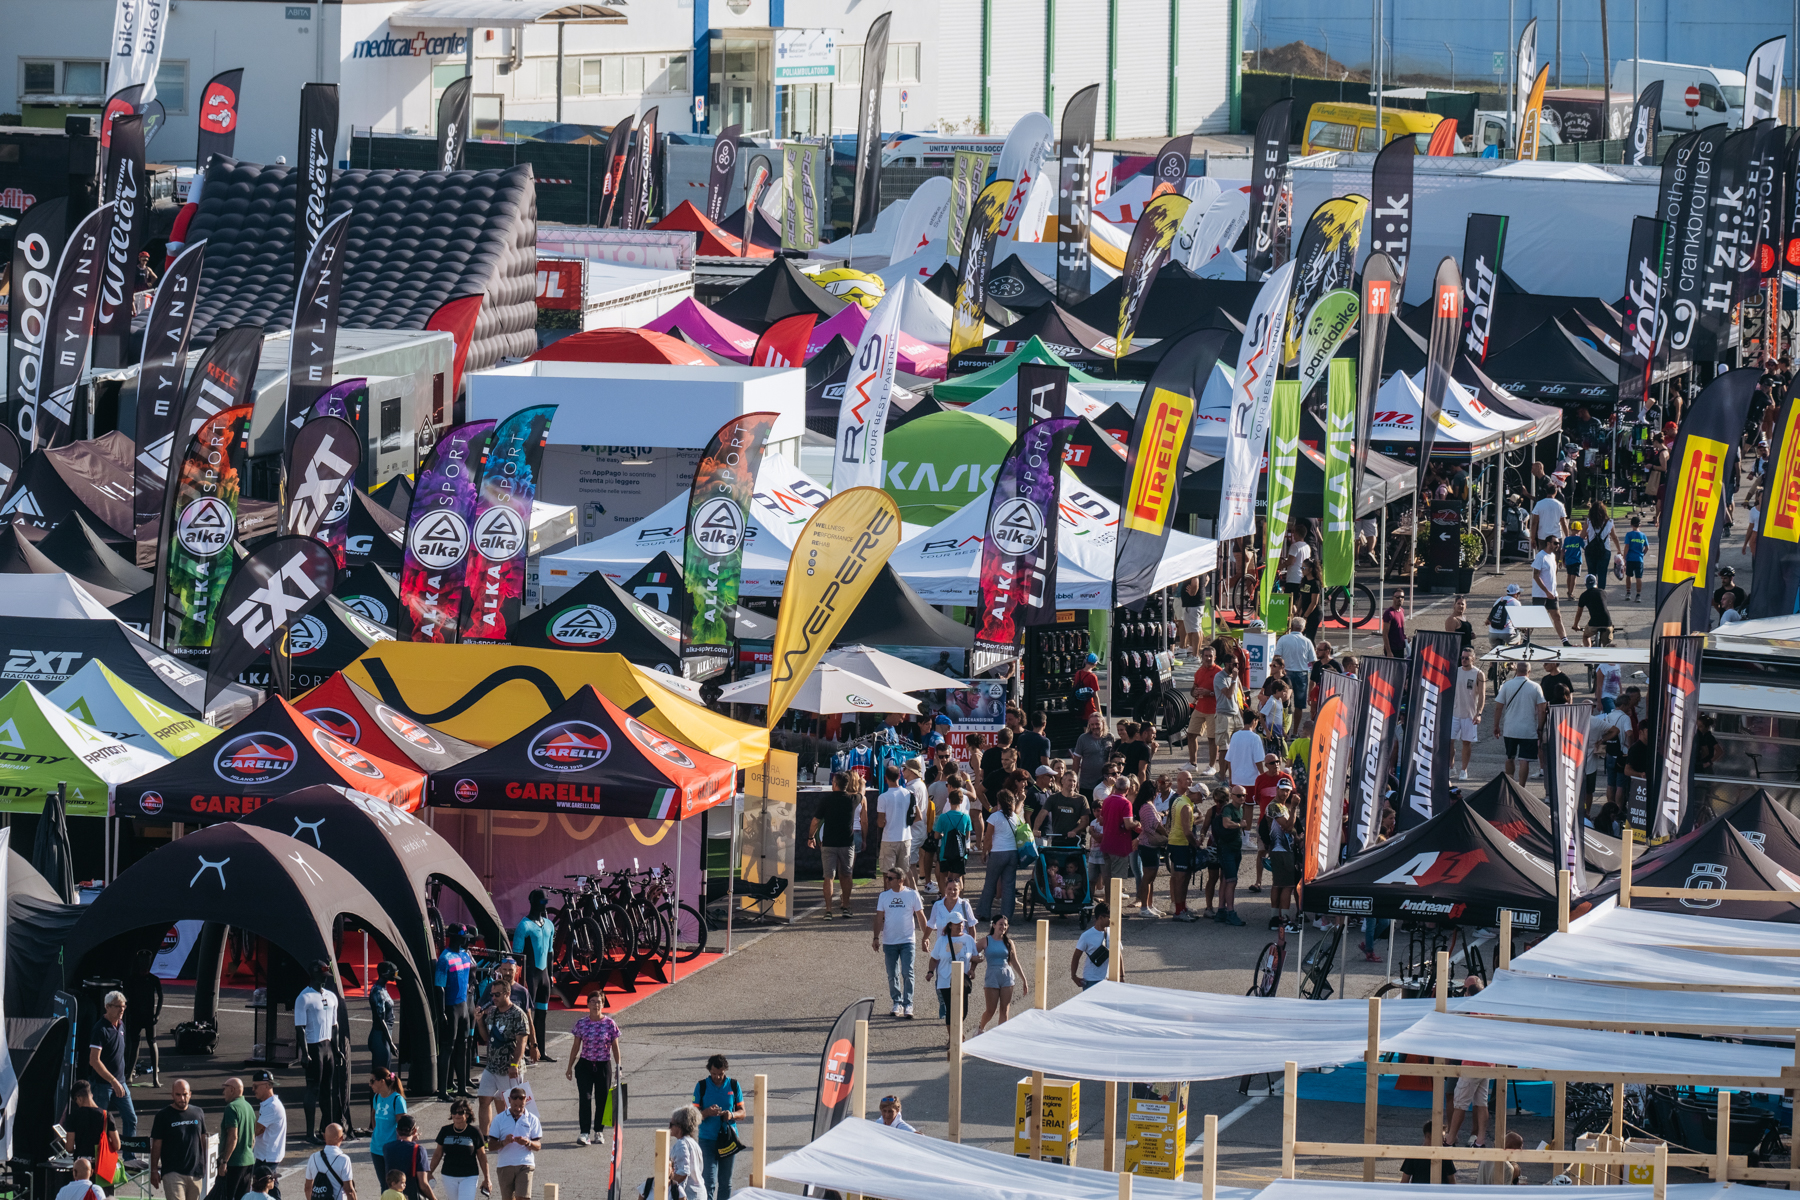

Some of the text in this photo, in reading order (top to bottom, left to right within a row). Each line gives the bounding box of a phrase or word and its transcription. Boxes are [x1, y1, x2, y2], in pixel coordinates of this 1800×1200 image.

[782, 66, 829, 77] POLIAMBULATORIO
[1577, 117, 1592, 128] EAT
[308, 128, 317, 181] TRIESTINA
[640, 123, 651, 217] ANACONDA
[113, 157, 127, 214] TRIESTINA
[802, 149, 814, 246] AGRESSIVE
[1679, 141, 1713, 292] crankbrothers
[1372, 287, 1387, 307] 3T
[1442, 291, 1456, 312] 3T
[1303, 301, 1359, 380] pandabike
[869, 429, 879, 465] YOUR
[874, 395, 887, 426] BEST
[1254, 407, 1268, 441] YOUR
[203, 422, 227, 492] SPORT
[439, 435, 467, 506] SPORT
[497, 433, 524, 502] SPORT
[592, 469, 622, 478] AppPago
[719, 424, 748, 494] SPORT
[1020, 426, 1052, 495] SPORT
[1133, 402, 1185, 522] PIRELLI
[1328, 411, 1354, 533] KASK
[579, 477, 604, 485] diventa
[614, 478, 640, 487] leggero
[1268, 434, 1299, 559] KASK
[815, 522, 846, 533] WELLNESS
[1672, 449, 1719, 574] PIRELLI
[185, 528, 227, 545] alka
[418, 542, 461, 558] alka
[480, 535, 518, 551] alka
[699, 529, 739, 546] alka
[811, 539, 831, 548] REHAB
[813, 530, 854, 543] PERFORMANCE
[996, 526, 1039, 547] alka
[193, 561, 211, 625] ALKA
[420, 575, 442, 638] ALKA
[483, 564, 502, 627] ALKA
[703, 560, 721, 623] ALKA
[991, 560, 1016, 622] ALKA
[556, 623, 602, 639] alka
[685, 645, 728, 655] alka-sport.com
[3, 672, 41, 680] RACING
[220, 759, 289, 771] GARELLI
[534, 748, 602, 760] GARELLI
[544, 762, 569, 770] MILANO
[1410, 678, 1440, 820] Andreani
[1662, 684, 1685, 827] Andreani
[230, 774, 254, 782] MILANO
[505, 782, 601, 803] GARELLI
[1357, 705, 1386, 851] Andreani
[1331, 897, 1371, 911] ÖHLINS
[1400, 899, 1453, 914] Andreani
